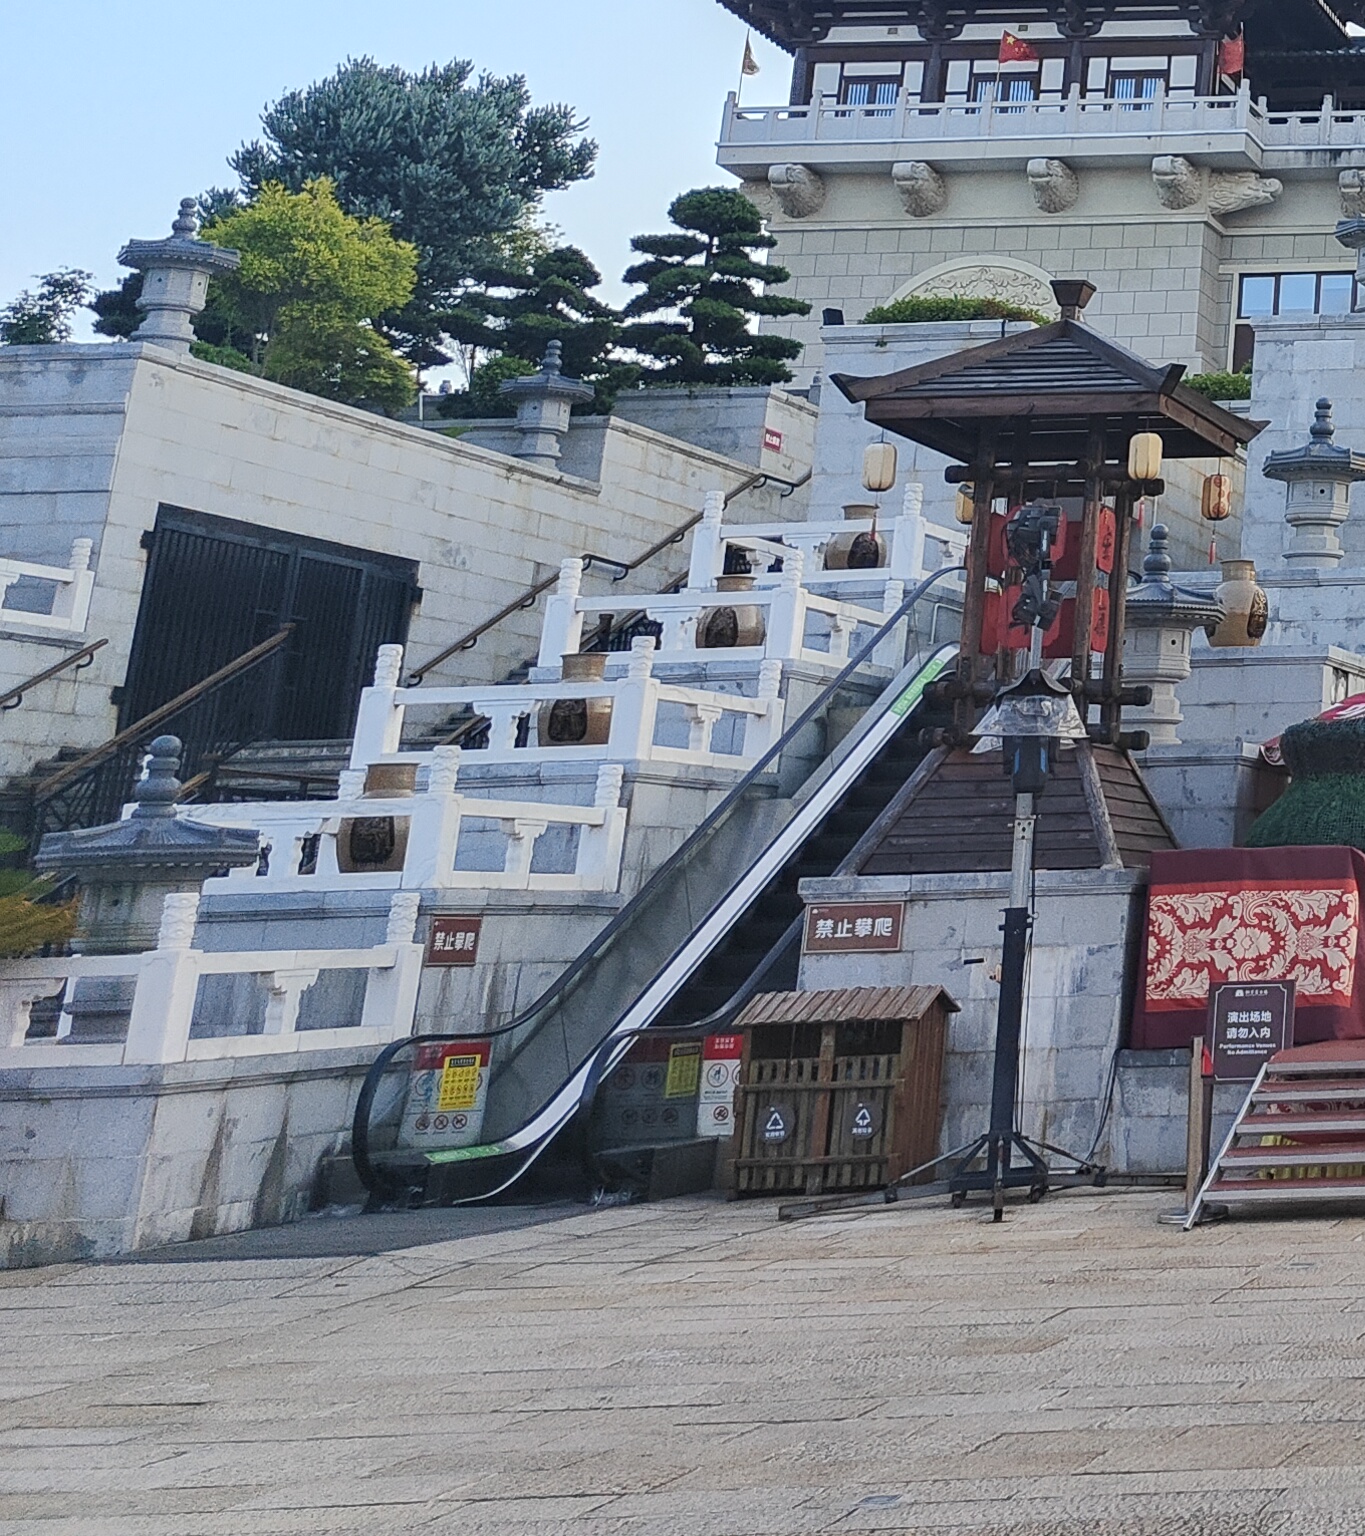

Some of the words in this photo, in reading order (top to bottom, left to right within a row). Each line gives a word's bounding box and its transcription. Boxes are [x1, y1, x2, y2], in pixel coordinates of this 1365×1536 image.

[815, 917, 893, 939] 禁止攀爬
[1227, 1010, 1272, 1024] 演出场地
[1226, 1026, 1271, 1039] 请勿入内
